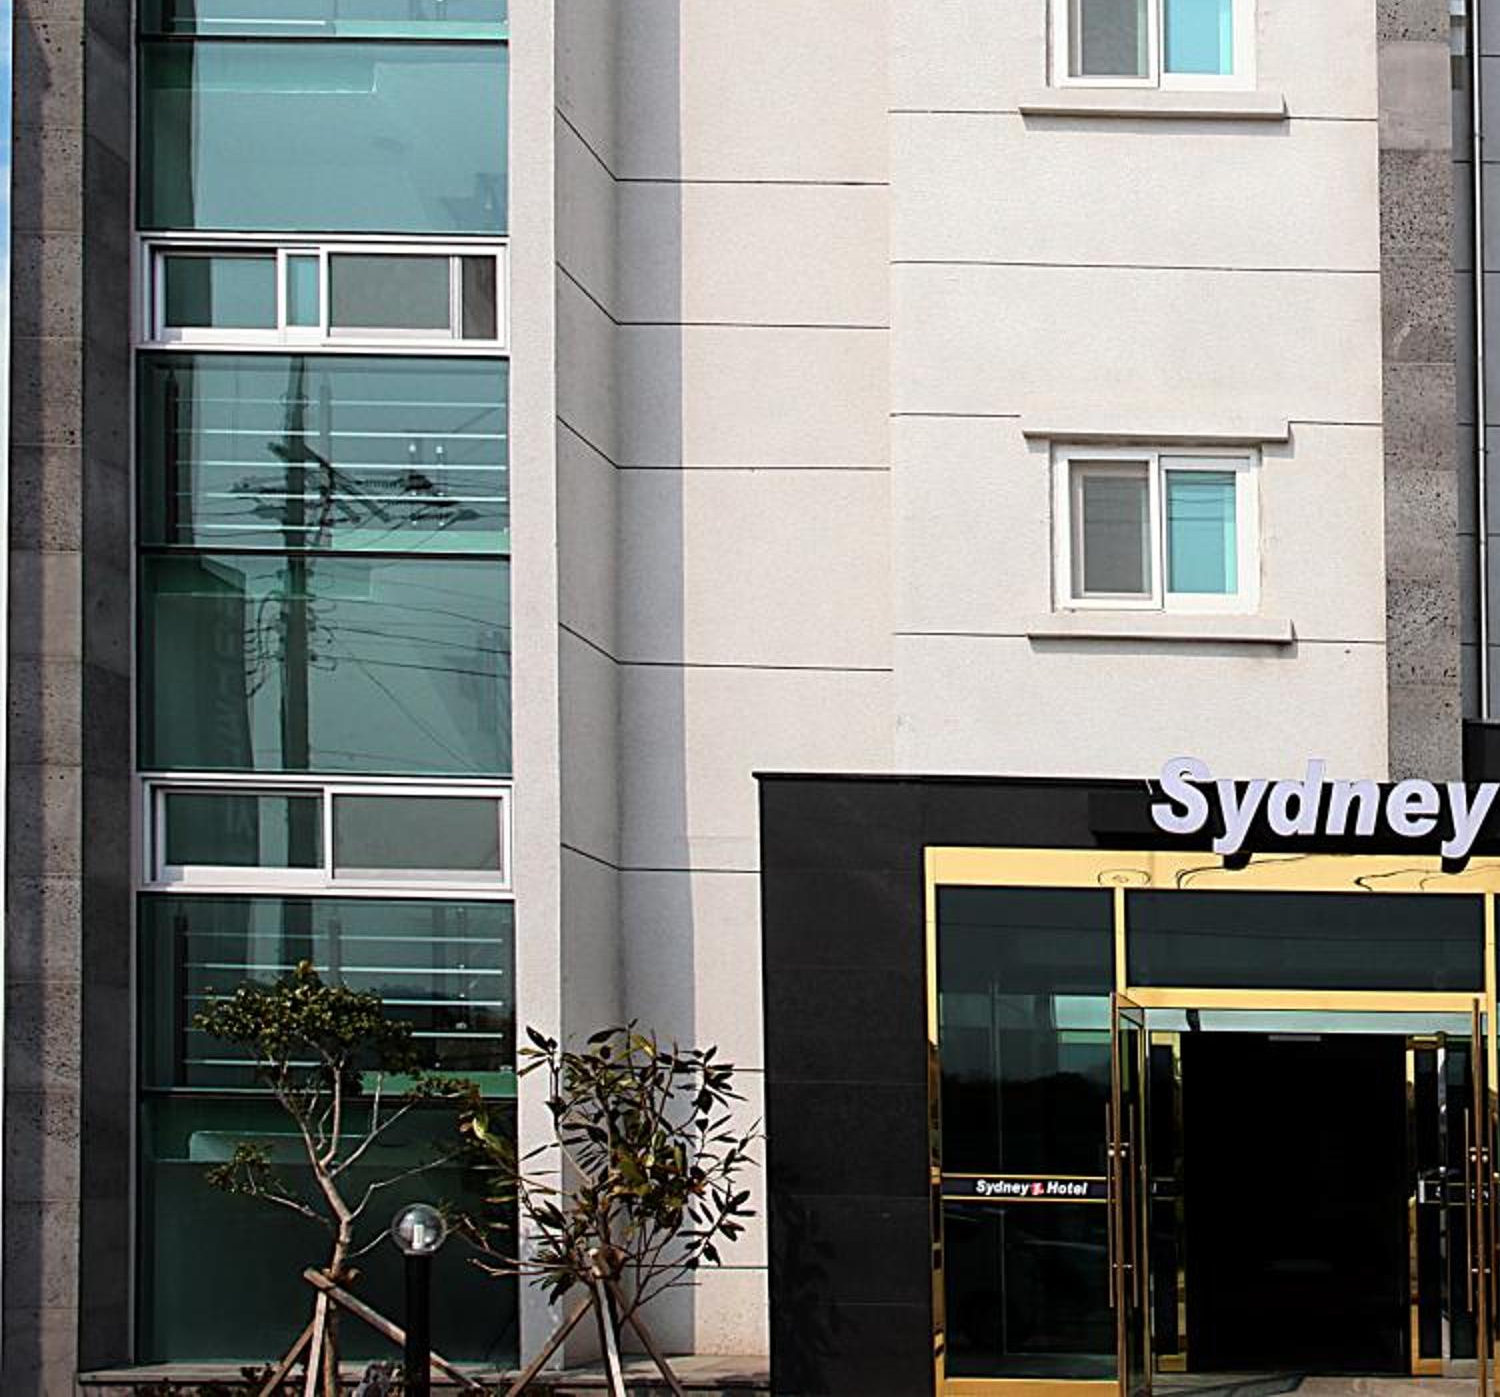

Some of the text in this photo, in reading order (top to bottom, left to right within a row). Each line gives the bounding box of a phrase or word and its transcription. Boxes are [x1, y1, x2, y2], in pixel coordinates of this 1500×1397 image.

[1151, 756, 1500, 858] Sydney
[975, 1179, 1030, 1196] Sydney
[1046, 1180, 1089, 1195] Hotel
